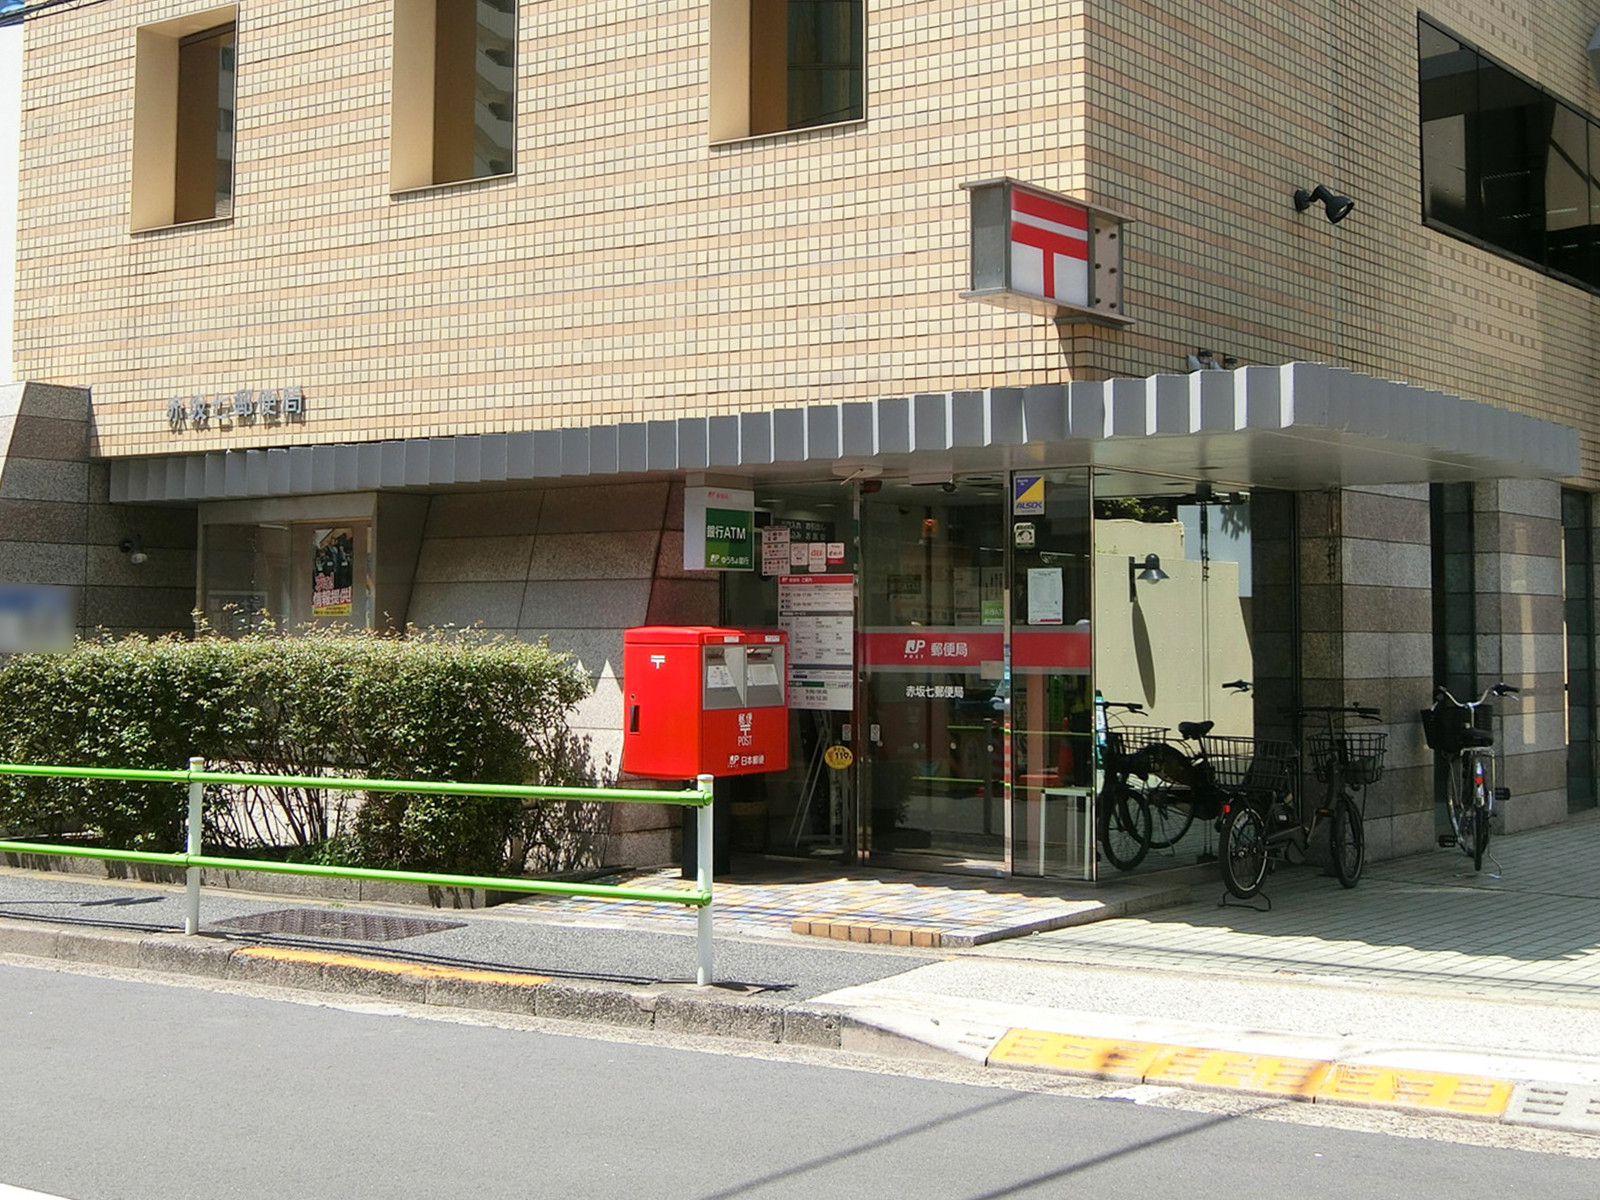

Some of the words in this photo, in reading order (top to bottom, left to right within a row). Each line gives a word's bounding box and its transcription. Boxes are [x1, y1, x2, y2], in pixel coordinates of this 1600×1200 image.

[707, 525, 746, 539] 銀行ATM
[721, 556, 749, 566] ゆうちょ銀行
[931, 642, 968, 657] 郵便局
[906, 685, 964, 699] 赤坂七郵便局
[737, 735, 752, 747] POST
[741, 754, 765, 766] 日本郵便
